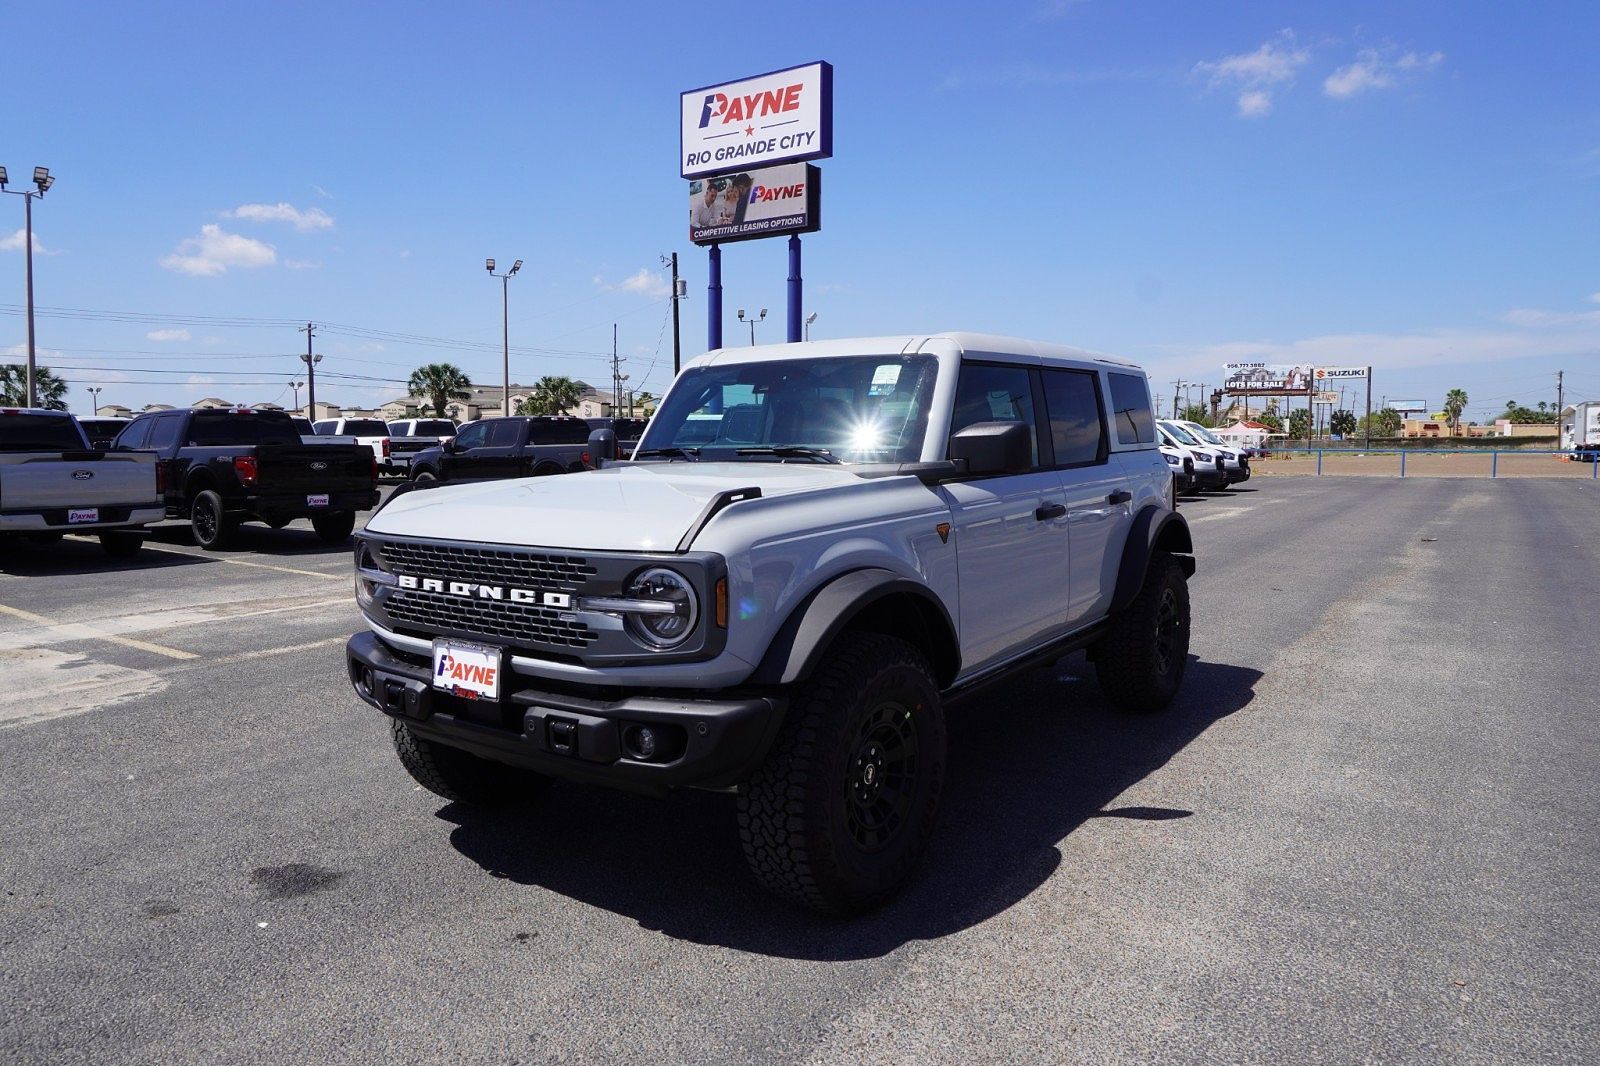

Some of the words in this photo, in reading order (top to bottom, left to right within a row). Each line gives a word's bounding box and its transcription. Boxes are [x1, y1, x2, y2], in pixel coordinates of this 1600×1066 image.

[698, 83, 804, 128] PAYNE
[686, 150, 711, 167] RIO
[715, 138, 777, 161] GRANDE
[779, 130, 816, 151] CITY
[749, 183, 805, 205] PAYNE
[693, 225, 739, 239] COMPETITIVE
[739, 220, 770, 232] LEASING
[770, 216, 804, 228] OPTIONS
[1327, 369, 1365, 377] SUZUKI
[69, 512, 96, 520] PAYNE
[397, 575, 572, 608] BRONCO
[437, 654, 496, 686] PAYNE
